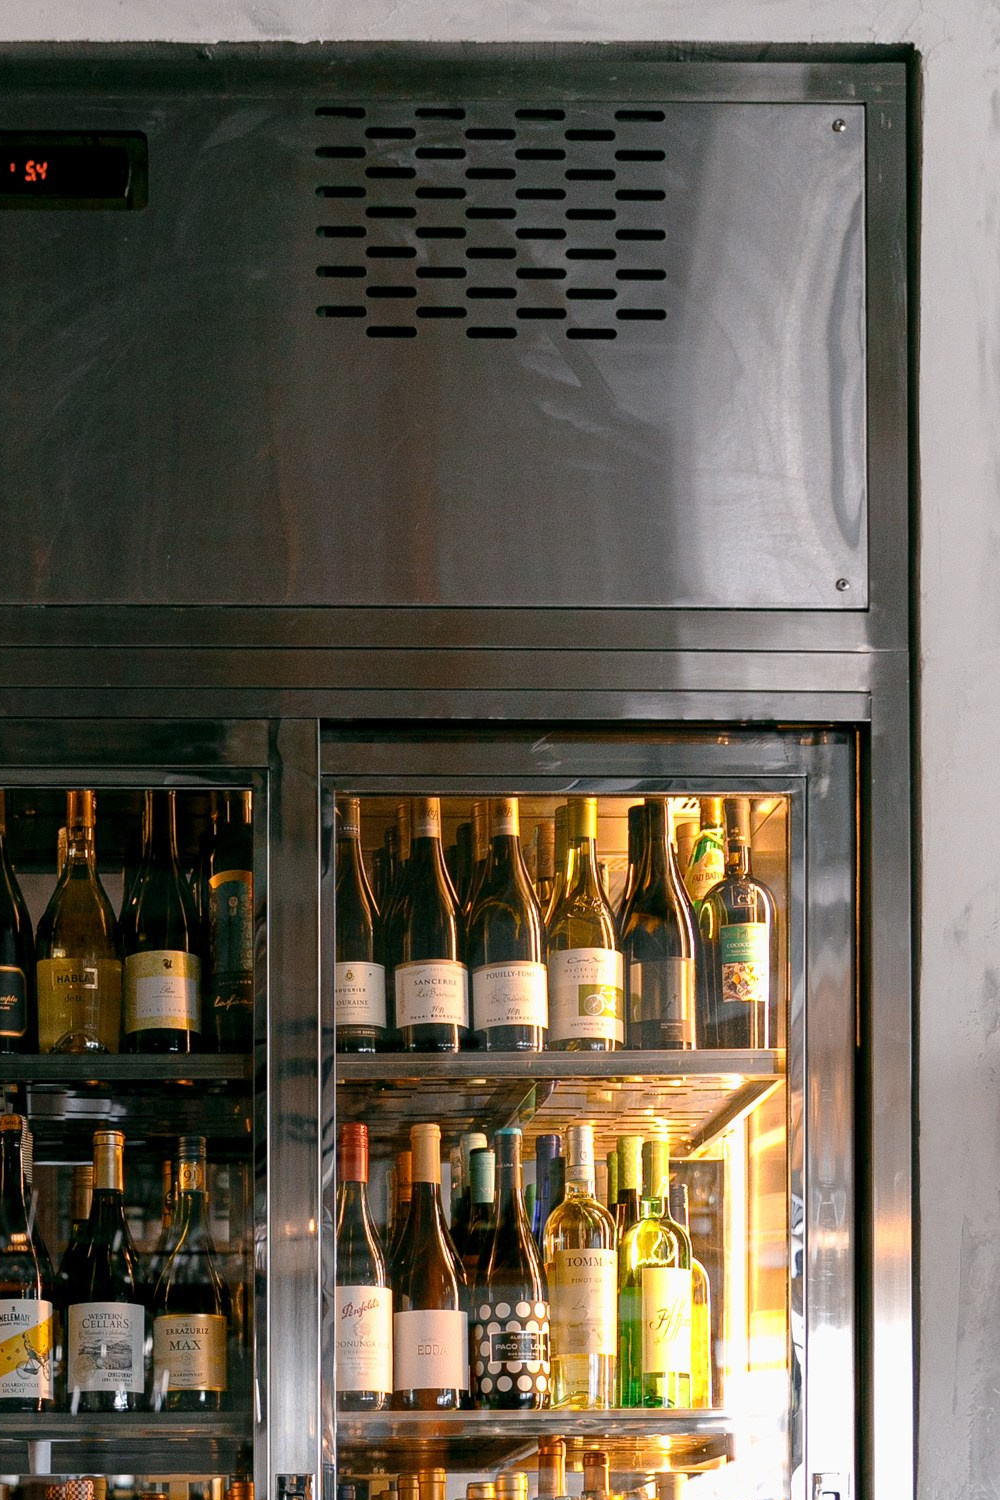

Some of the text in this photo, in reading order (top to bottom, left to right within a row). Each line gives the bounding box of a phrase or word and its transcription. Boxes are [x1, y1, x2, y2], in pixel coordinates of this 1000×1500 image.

[56, 973, 91, 984] HABLA
[413, 978, 458, 987] SANCERRE
[341, 1297, 379, 1320] Penfolds
[81, 1318, 130, 1330] CELLARS
[165, 1327, 209, 1336] ERRAZURIZ
[169, 1340, 202, 1351] MAX
[417, 1344, 449, 1356] EDDA
